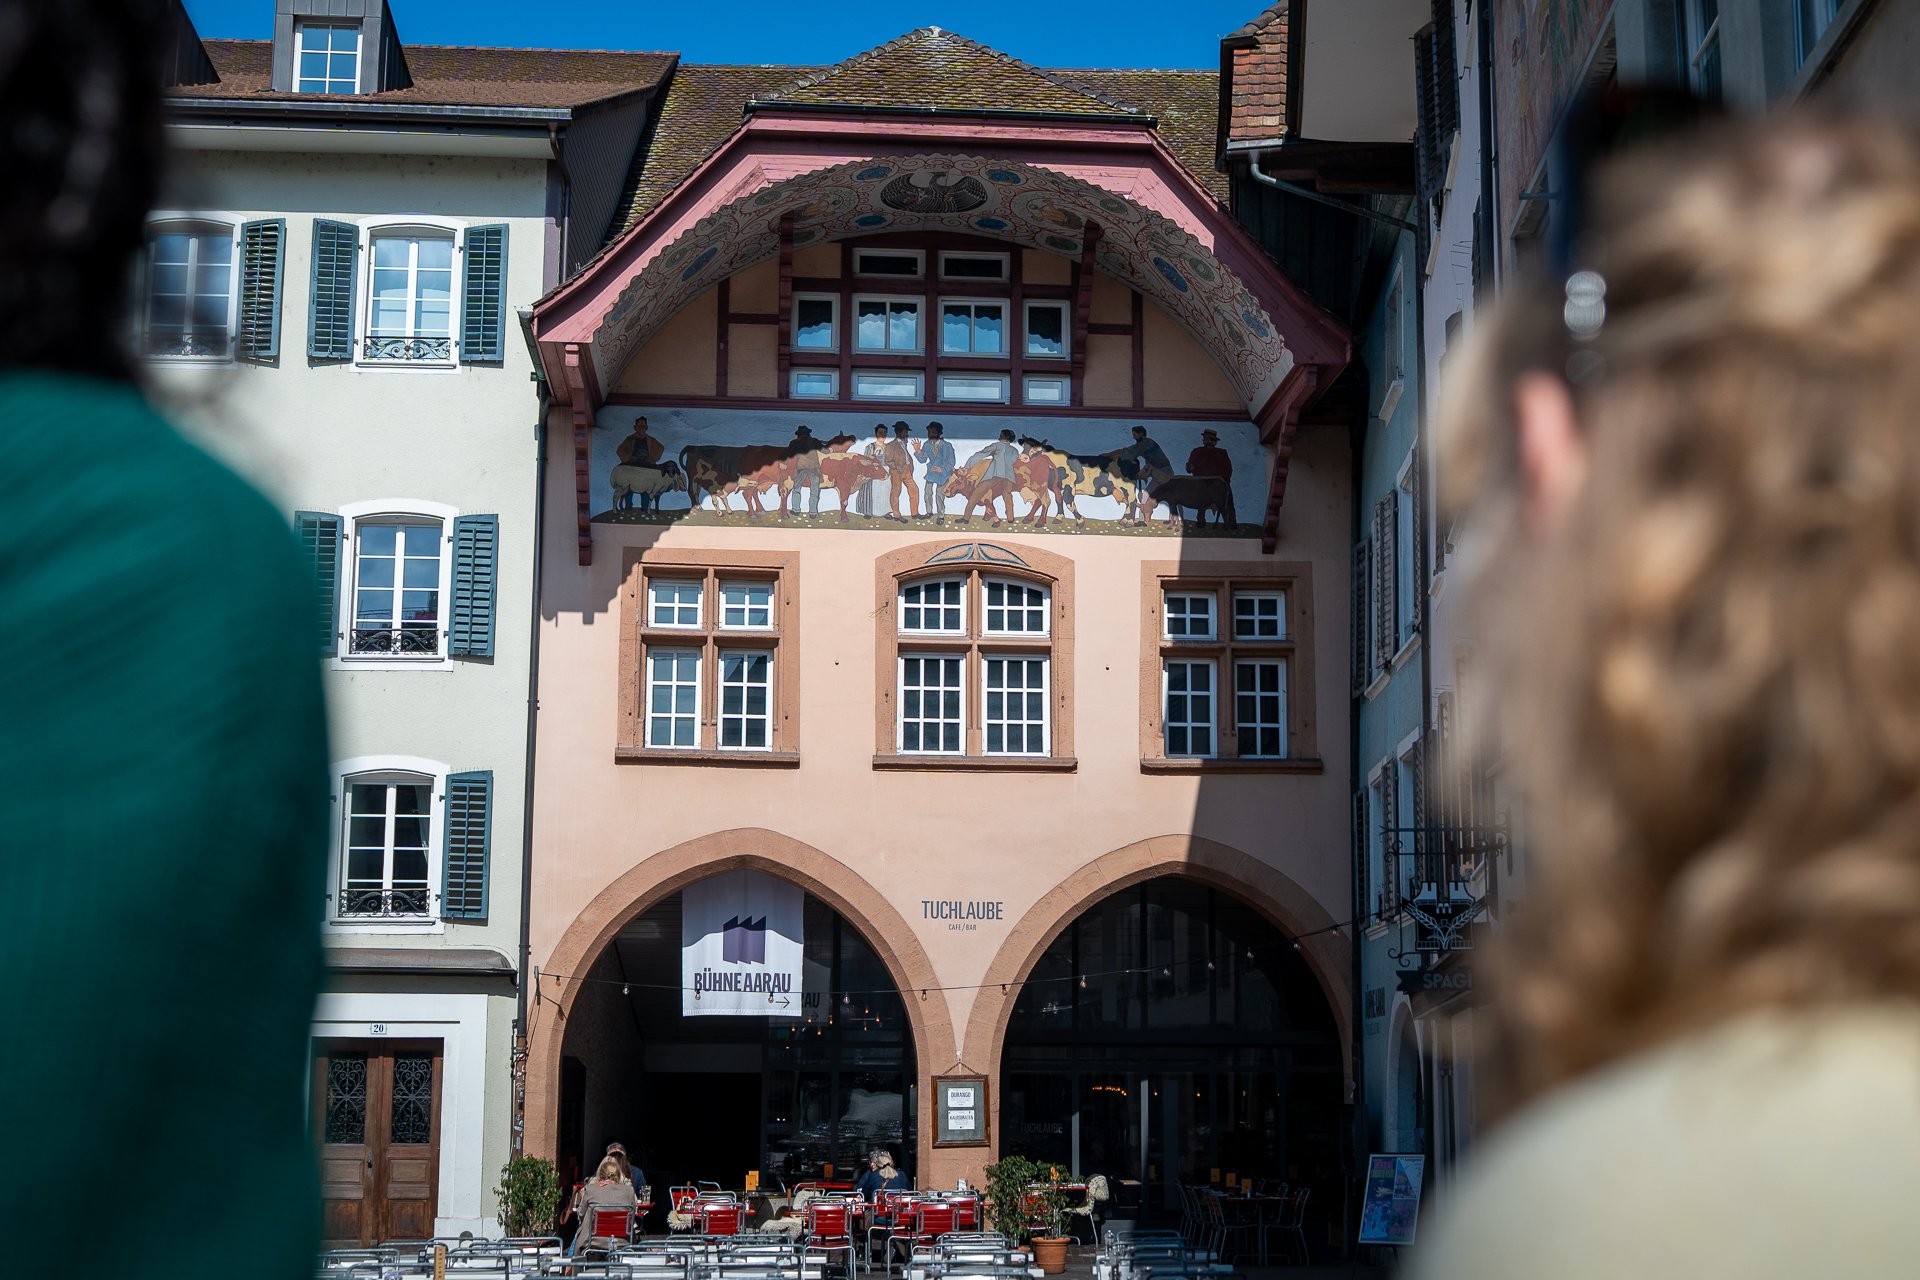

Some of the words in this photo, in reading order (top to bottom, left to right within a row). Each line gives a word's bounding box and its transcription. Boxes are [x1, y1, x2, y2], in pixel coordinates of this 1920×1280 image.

[921, 900, 1003, 920] TUCHLAUBE
[694, 967, 742, 992] BÜHNE
[743, 972, 792, 994] AARAU
[373, 1024, 384, 1033] 20
[1020, 1122, 1063, 1134] TUCHLAUBE
